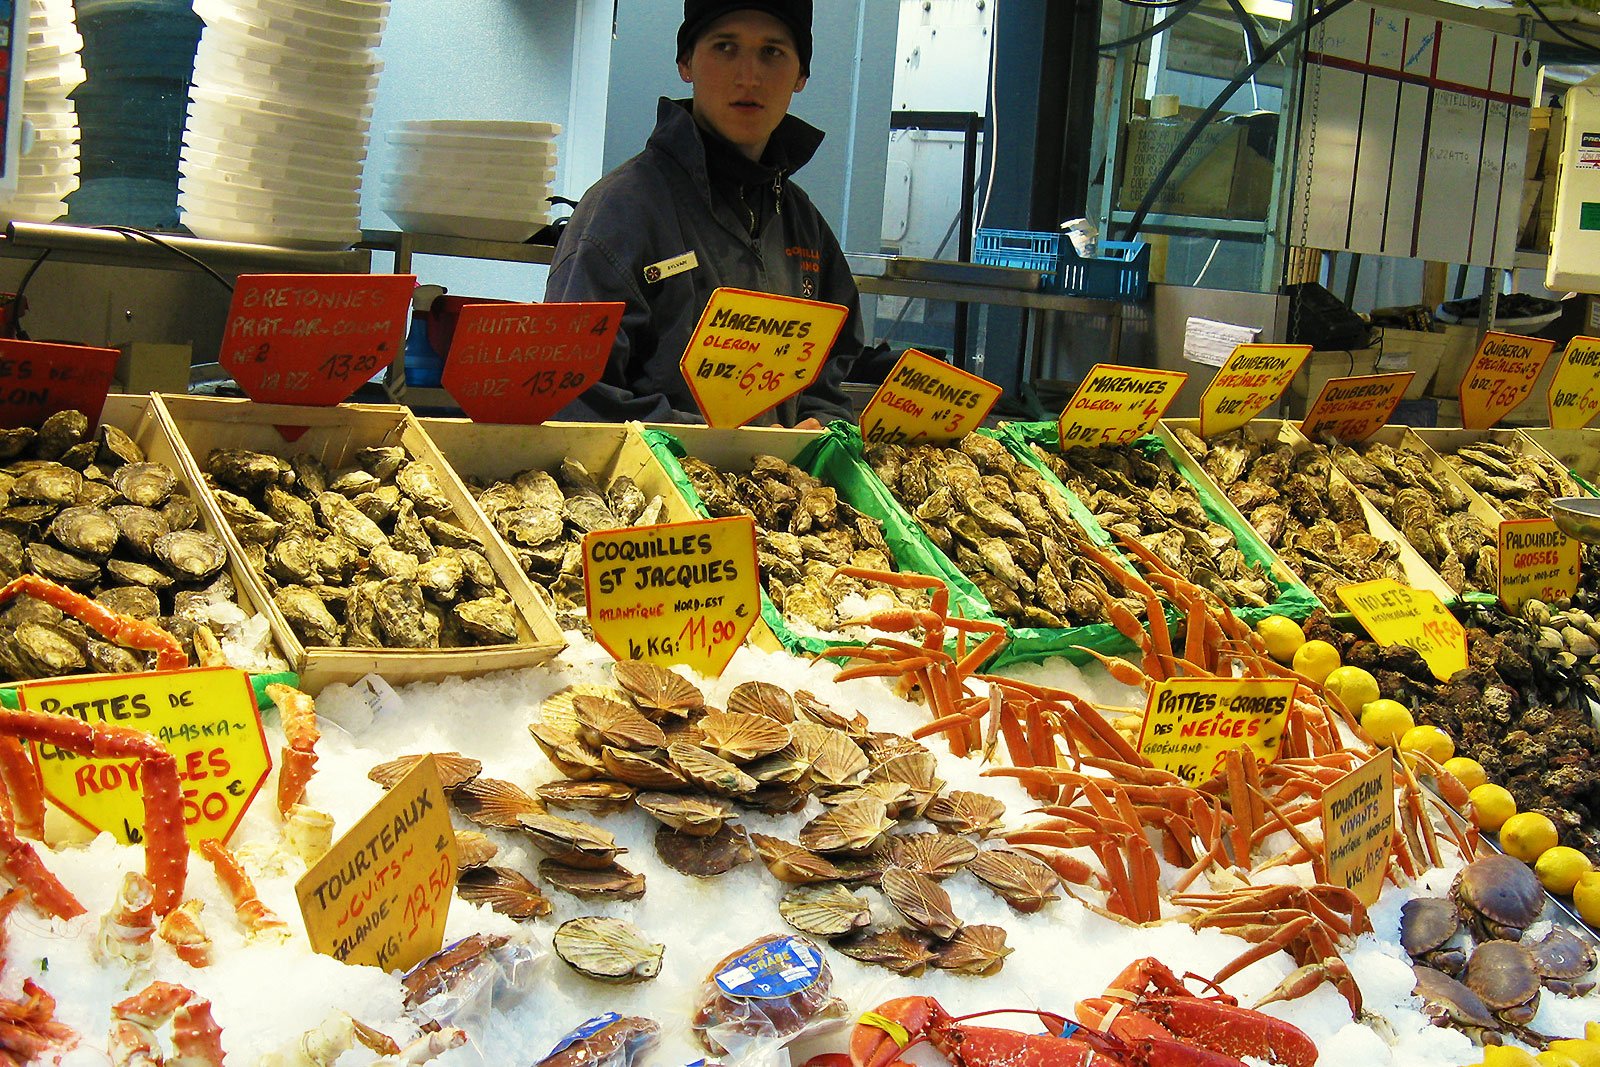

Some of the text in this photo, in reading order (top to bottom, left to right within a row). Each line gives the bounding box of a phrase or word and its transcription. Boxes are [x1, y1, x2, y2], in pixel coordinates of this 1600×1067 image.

[243, 287, 386, 309] BRETONNES
[590, 315, 609, 336] 4
[709, 308, 811, 338] MARENNES
[255, 343, 270, 363] 2
[703, 335, 760, 354] OLERON
[796, 342, 816, 362] 3
[1483, 339, 1533, 359] QUIBERON
[318, 353, 378, 382] 13,20
[1230, 355, 1291, 371] QUIBERON
[1525, 362, 1541, 380] 3
[522, 371, 585, 397] 13,20
[696, 358, 713, 379] la
[739, 362, 785, 396] 6,96
[892, 366, 981, 409] MARENNES
[1085, 376, 1168, 394] MARENNES
[1276, 369, 1292, 386] 2
[1325, 383, 1395, 401] QUIBERON
[1384, 396, 1399, 411] 3
[880, 391, 924, 418] OLERON
[944, 413, 965, 433] 3
[1075, 398, 1122, 412] OLERON
[1142, 398, 1158, 420] 4
[591, 533, 713, 563] COQUILLES
[1505, 530, 1567, 550] PALOURDES
[1513, 551, 1559, 569] GROSSES
[600, 559, 738, 594] ST JACQUES
[599, 595, 725, 623] ATLANTIQUE NORD-EST
[1354, 589, 1412, 611] VIOLETS
[629, 638, 644, 660] le
[679, 615, 736, 657] 11,90
[735, 604, 748, 618] €
[169, 690, 194, 709] DE
[1157, 690, 1217, 714] PATTES
[1229, 696, 1288, 715] CRABES
[1153, 723, 1173, 735] DES
[75, 747, 231, 796] ROYES
[226, 779, 246, 796] €
[1330, 774, 1383, 821] TOURTEAUX
[1340, 799, 1379, 837] VIVANTS
[312, 788, 433, 910] TOURTEAUX
[403, 854, 451, 940] 12,50
